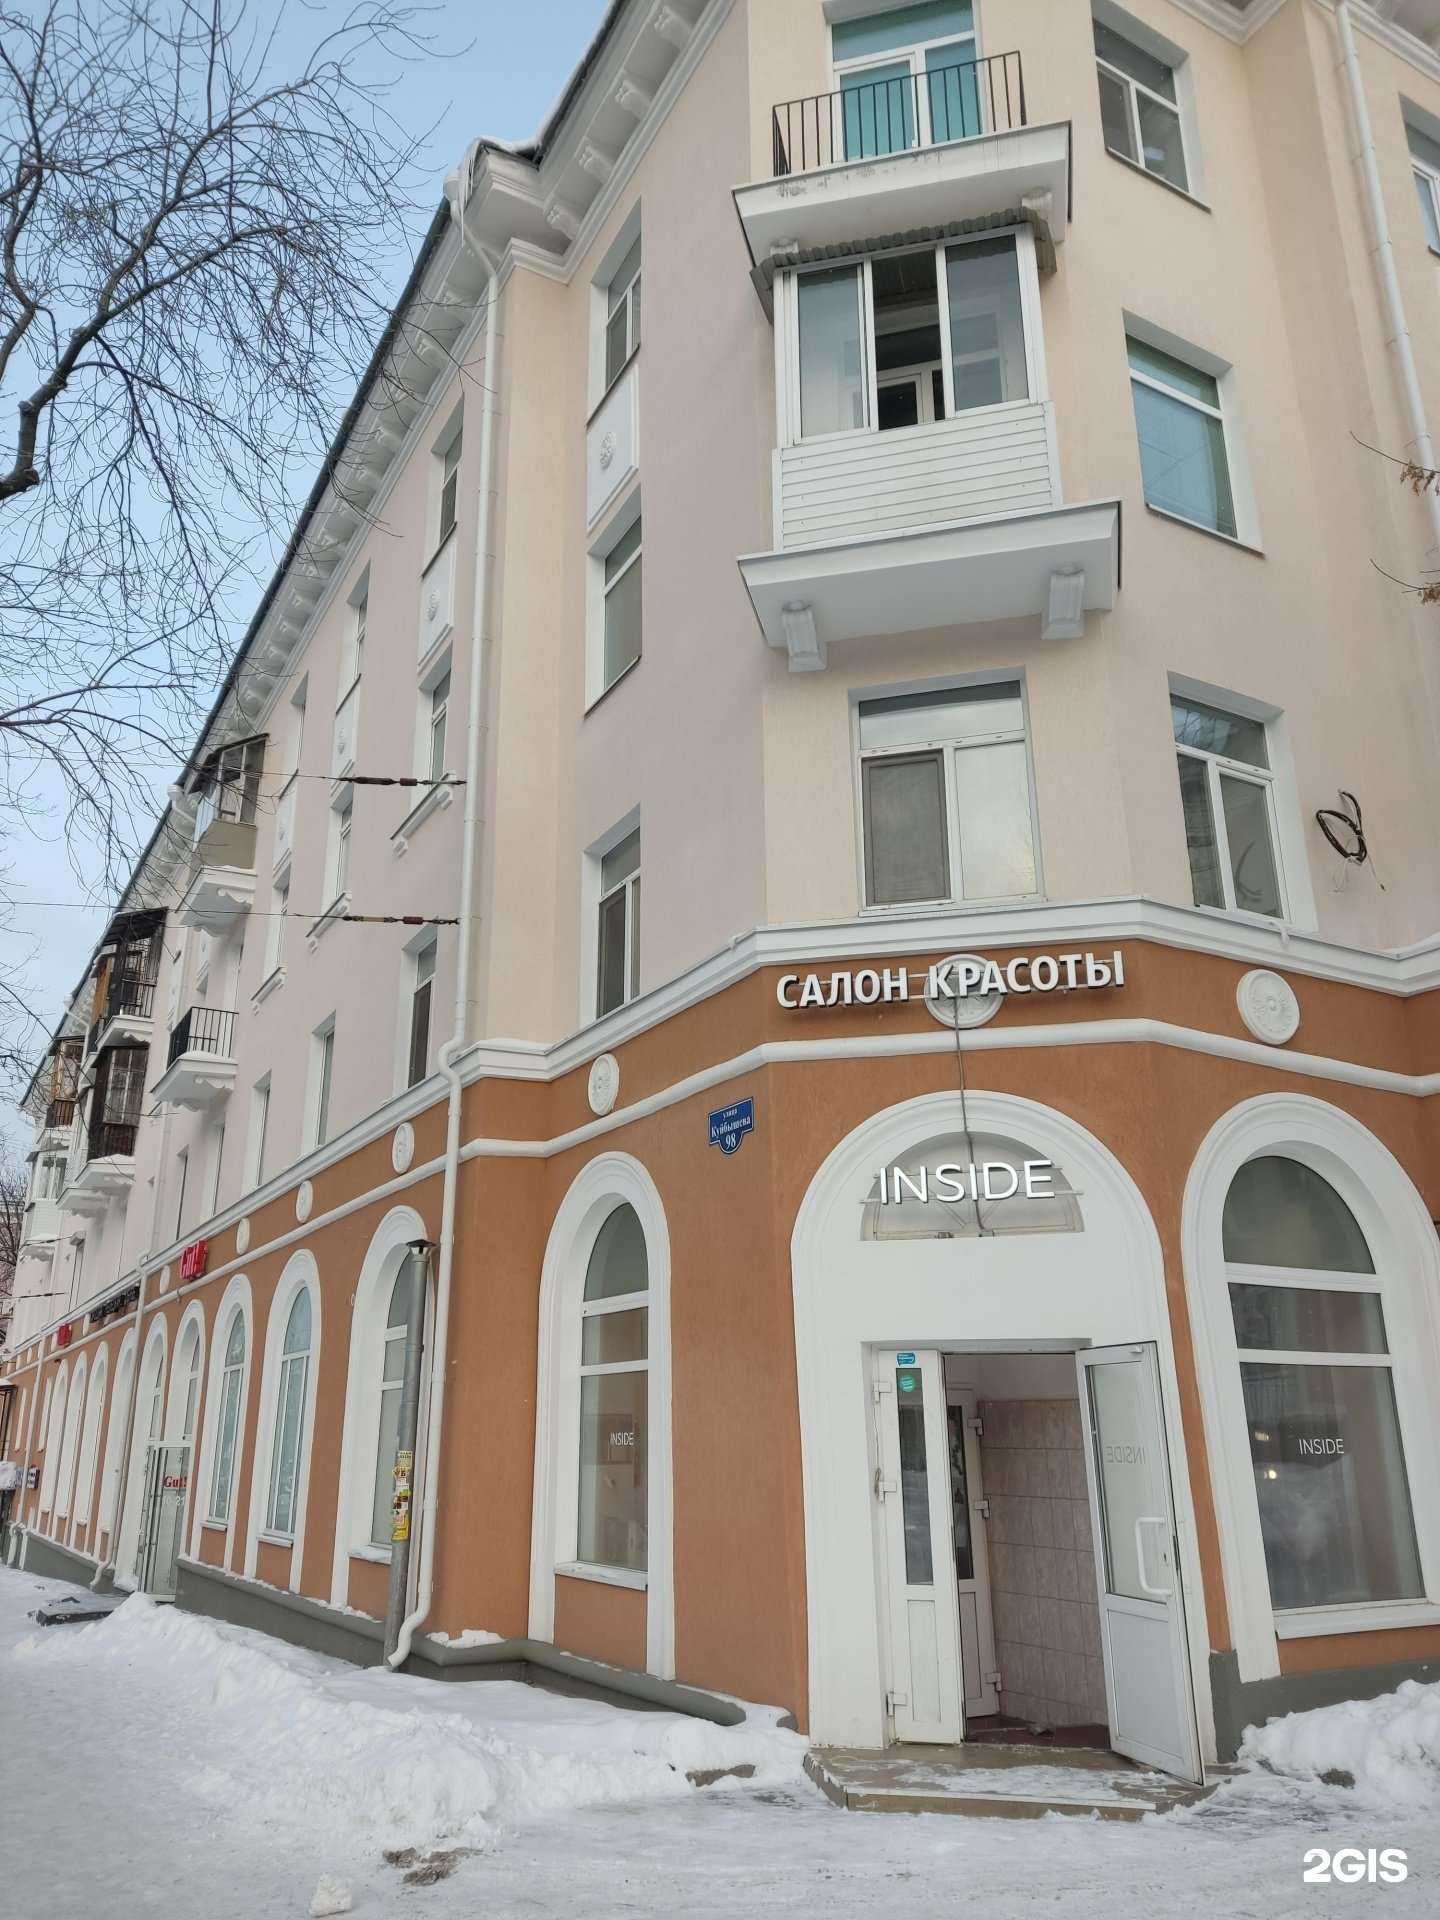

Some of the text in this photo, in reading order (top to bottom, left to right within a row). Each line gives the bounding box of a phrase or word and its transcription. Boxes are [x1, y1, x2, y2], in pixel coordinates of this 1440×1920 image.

[776, 950, 1126, 1009] САЛОН КРАСОТЫ
[725, 1132, 736, 1150] 98
[879, 1159, 1056, 1205] INSIDE
[609, 1431, 635, 1446] INSIDE
[1298, 1438, 1345, 1455] INSIDE
